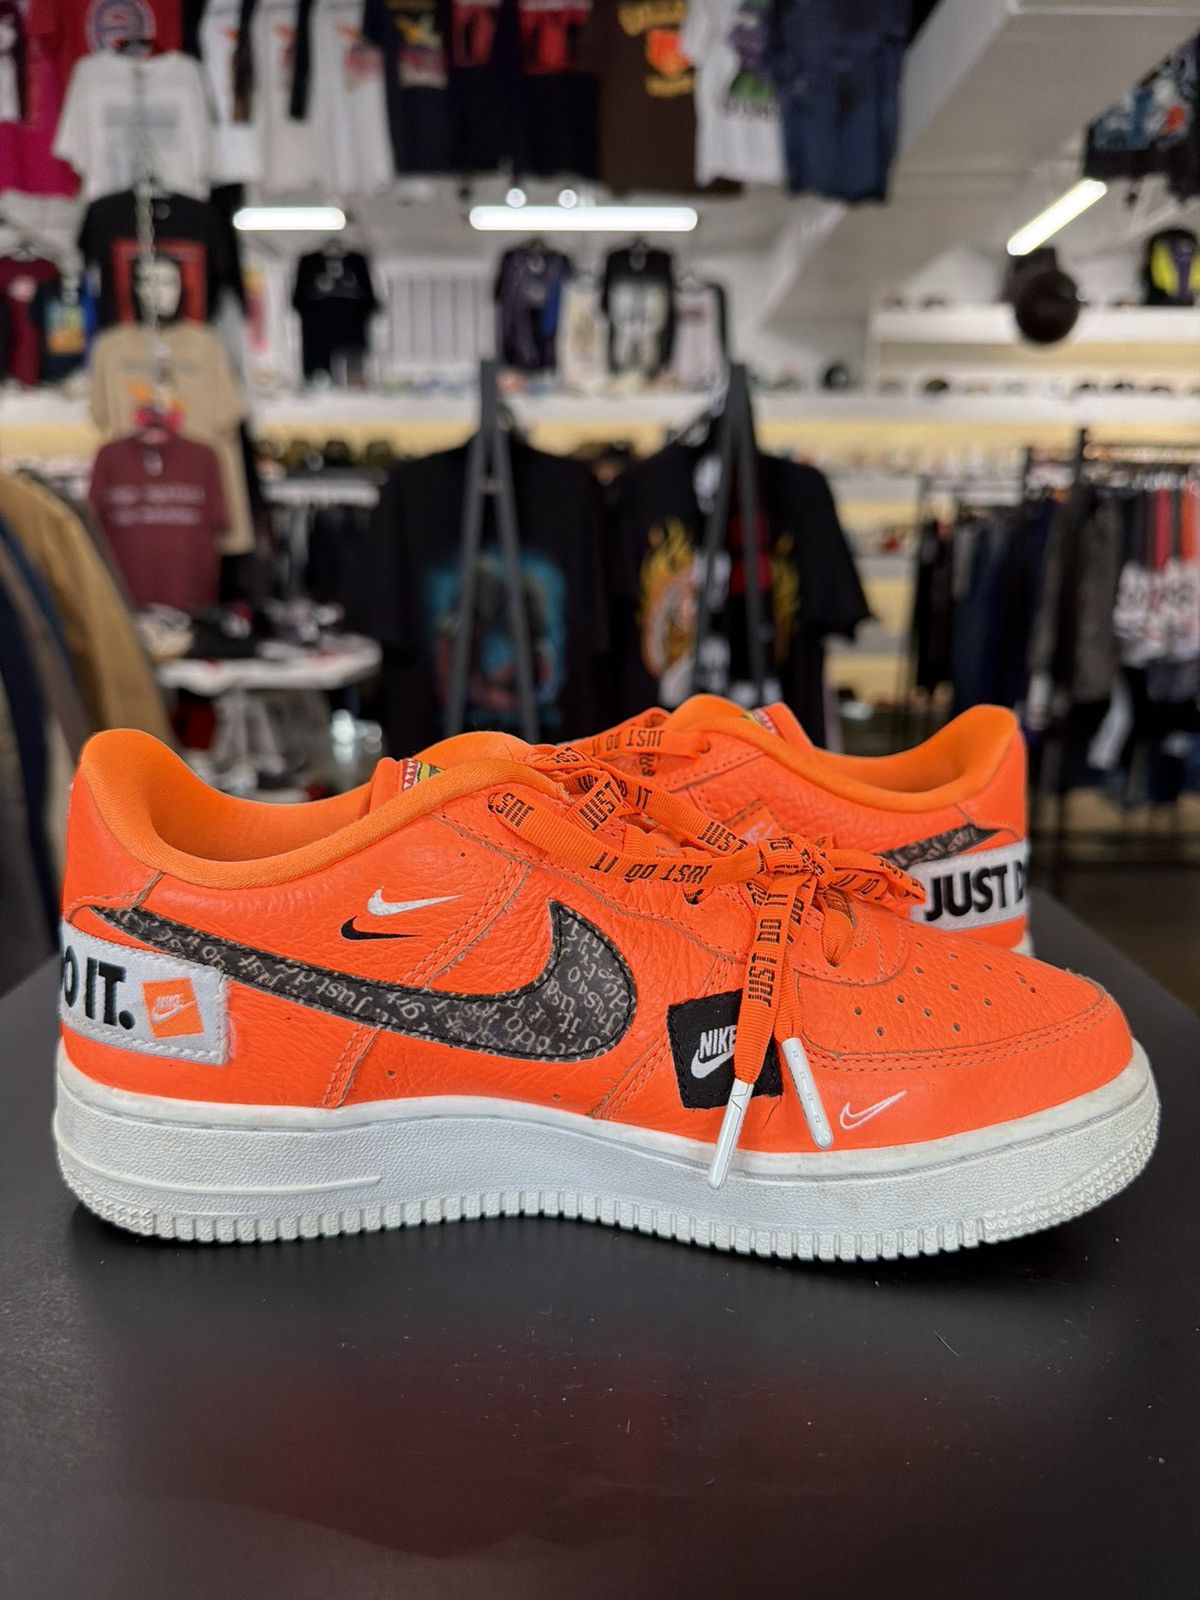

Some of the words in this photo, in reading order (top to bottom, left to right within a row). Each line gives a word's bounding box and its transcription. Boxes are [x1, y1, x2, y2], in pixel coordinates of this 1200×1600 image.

[624, 729, 665, 748] JUST
[577, 780, 622, 832] JUST
[635, 785, 653, 810] IT
[696, 820, 748, 856] JUST
[589, 851, 618, 874] IT
[624, 863, 659, 884] DO
[659, 863, 713, 884] JUST
[925, 864, 1008, 922] JUST
[756, 918, 783, 944] DO
[84, 956, 136, 1030] IT.
[747, 951, 775, 1008] JUST
